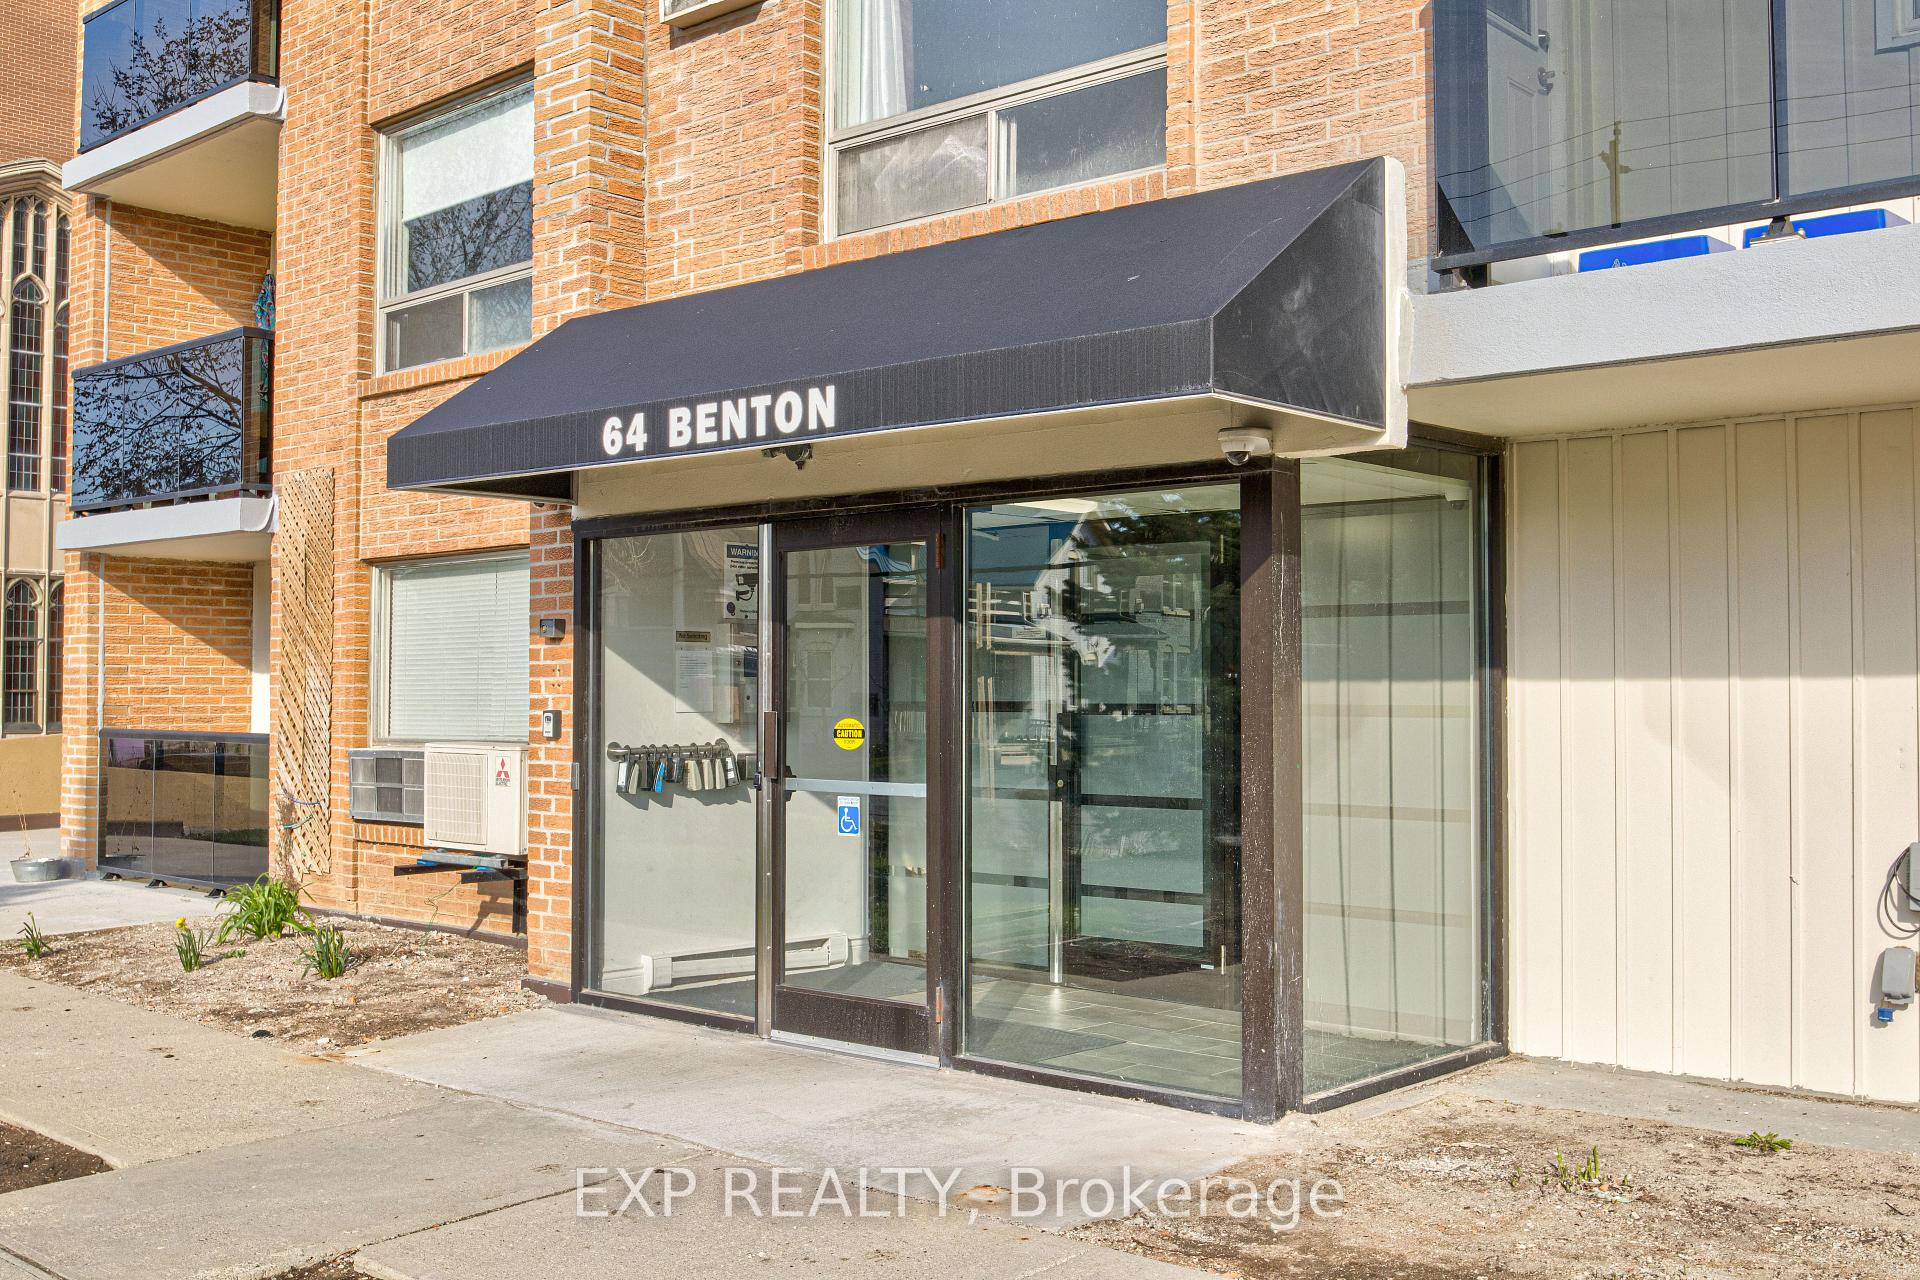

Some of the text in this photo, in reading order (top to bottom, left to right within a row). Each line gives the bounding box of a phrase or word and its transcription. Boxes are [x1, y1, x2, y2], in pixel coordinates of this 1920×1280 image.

[603, 385, 836, 456] 64 BENTON
[836, 729, 863, 738] CAUTION
